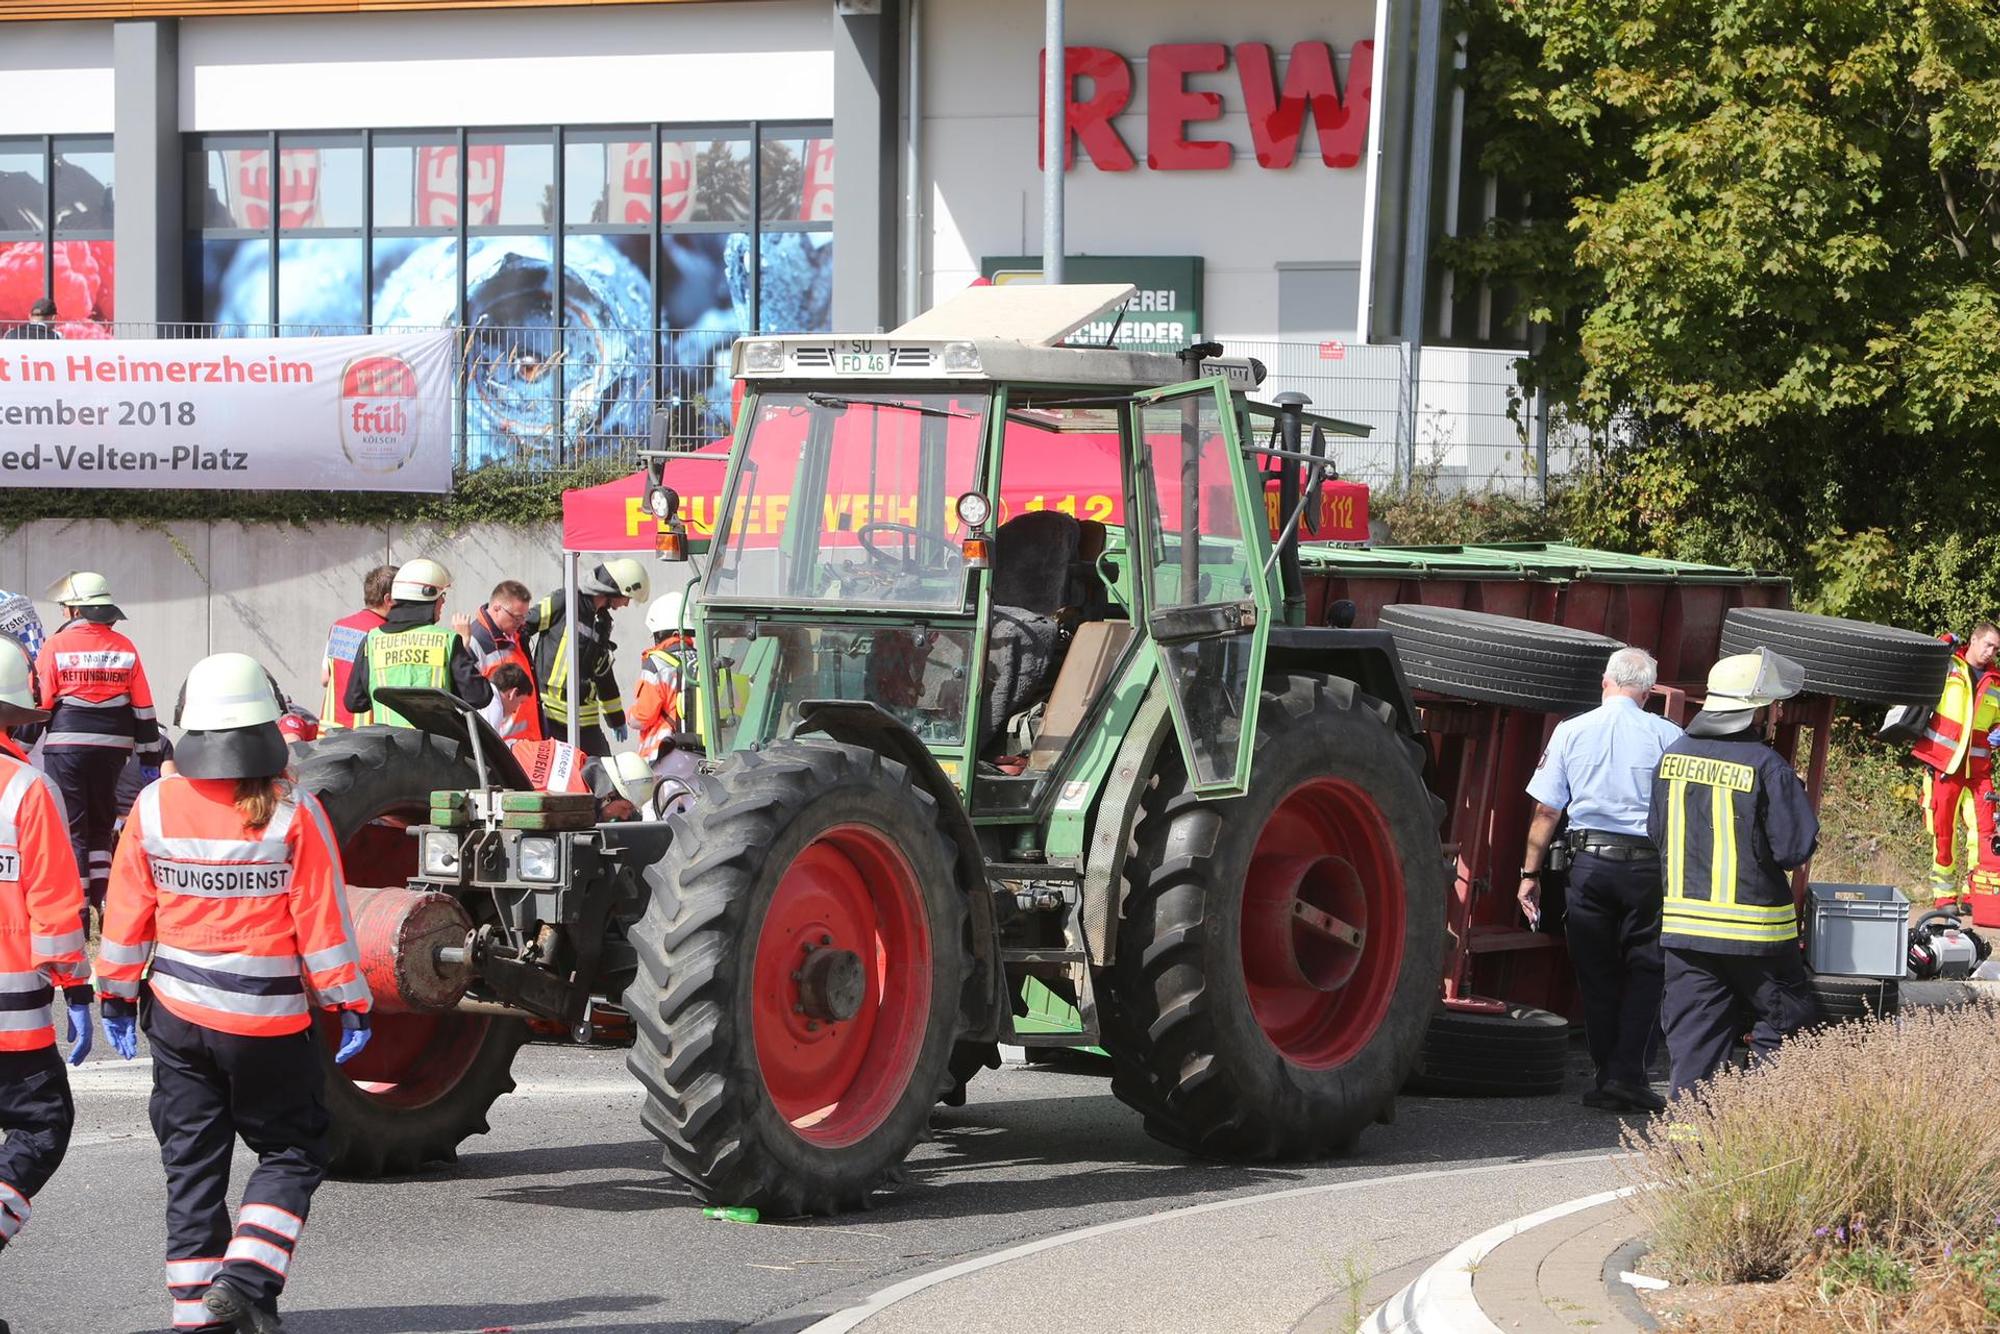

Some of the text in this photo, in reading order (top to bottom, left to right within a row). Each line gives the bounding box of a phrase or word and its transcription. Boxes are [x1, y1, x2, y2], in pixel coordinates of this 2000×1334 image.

[1039, 40, 1375, 171] REW
[1114, 289, 1176, 312] EREI
[852, 339, 872, 354] SU
[20, 354, 56, 382] in
[66, 354, 314, 383] Heimerzheim
[842, 355, 884, 372] FD 46
[1202, 364, 1248, 381] FENDT
[118, 400, 196, 427] 2018
[352, 401, 407, 437] früh
[362, 436, 397, 445] KÖLSCH
[0, 443, 249, 471] ed-Velten-Platz
[1330, 495, 1353, 529] 112
[374, 633, 444, 650] FEUERWEHR
[385, 649, 430, 665] PRESSE
[1661, 756, 1753, 790] FEUERWEHR
[153, 862, 289, 891] RETTUNGSDIENST
